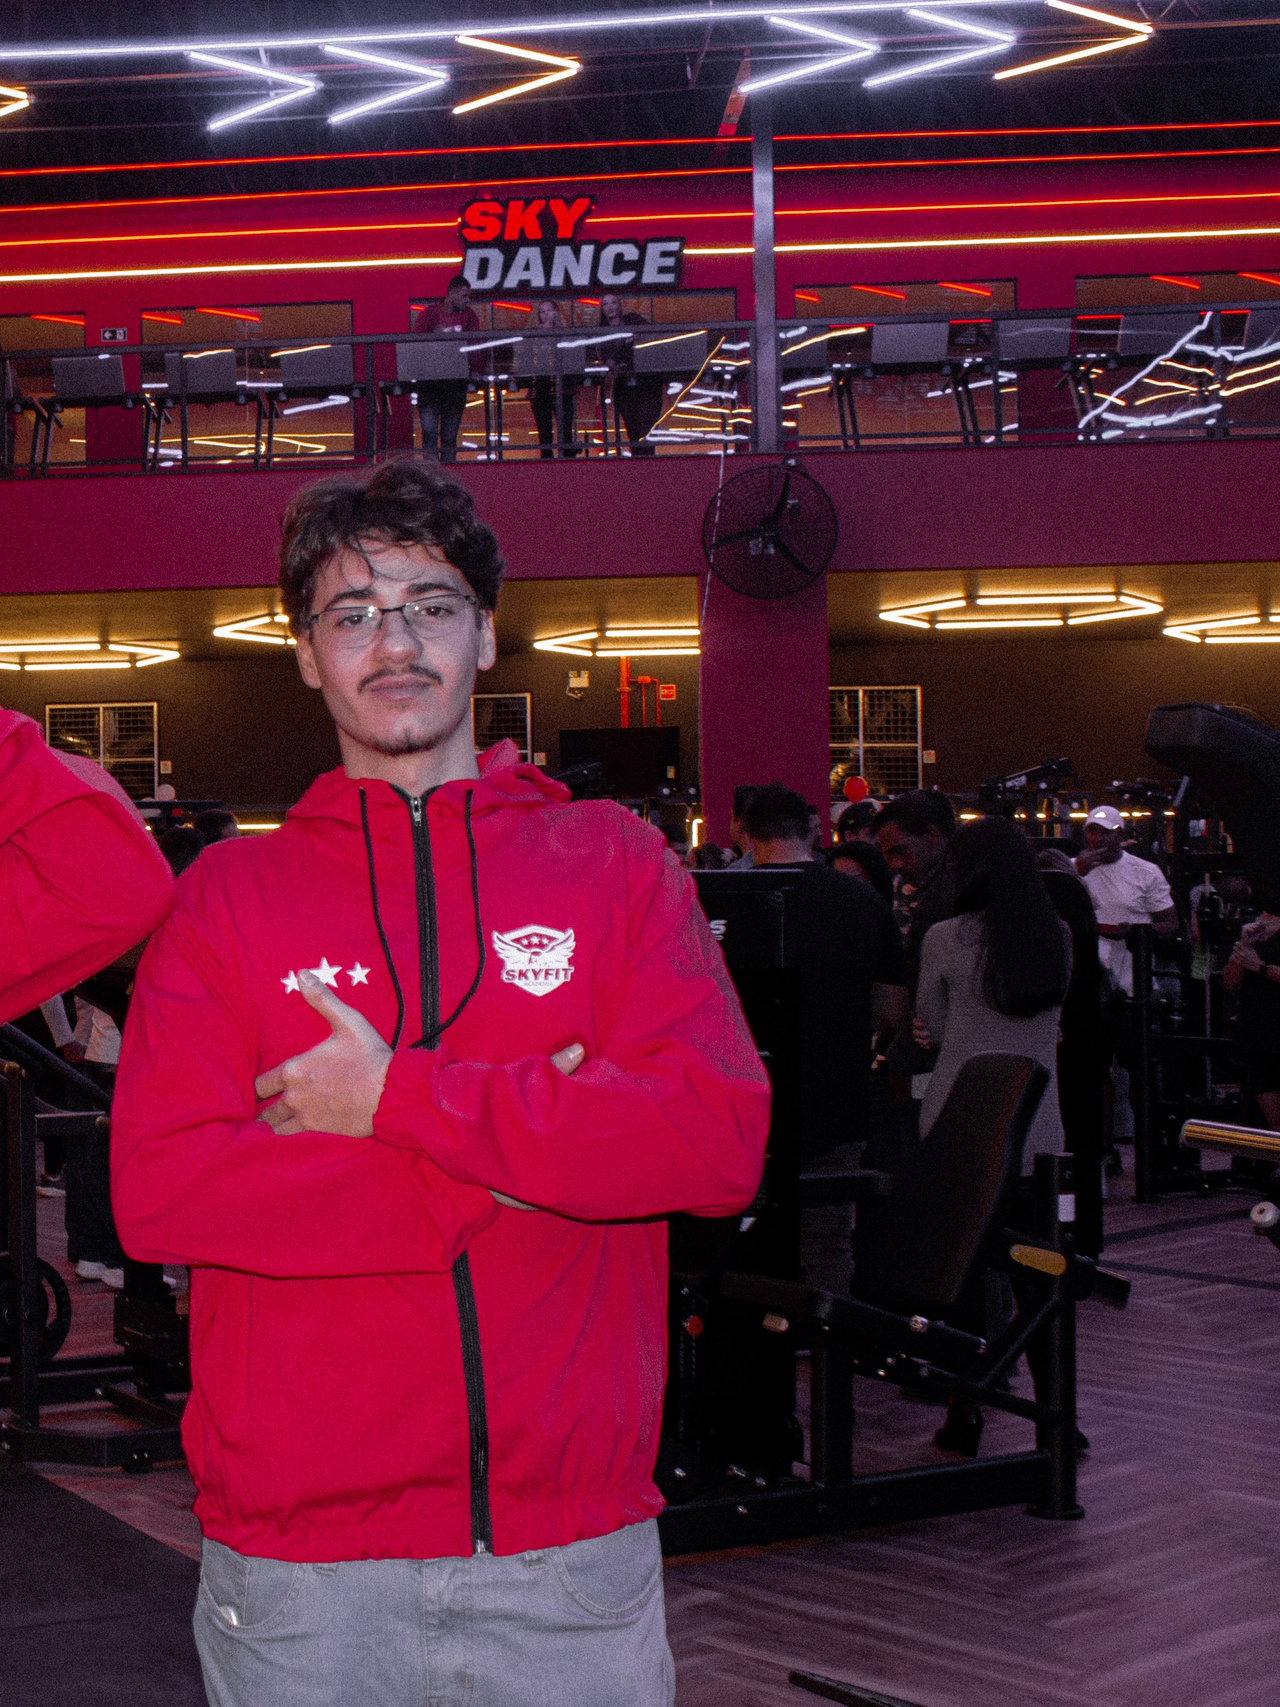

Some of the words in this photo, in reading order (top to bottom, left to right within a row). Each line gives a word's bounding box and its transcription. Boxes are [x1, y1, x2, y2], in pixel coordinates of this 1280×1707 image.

[462, 198, 591, 242] SKY
[463, 241, 681, 289] DANCE
[504, 967, 573, 981] SKYFIT
